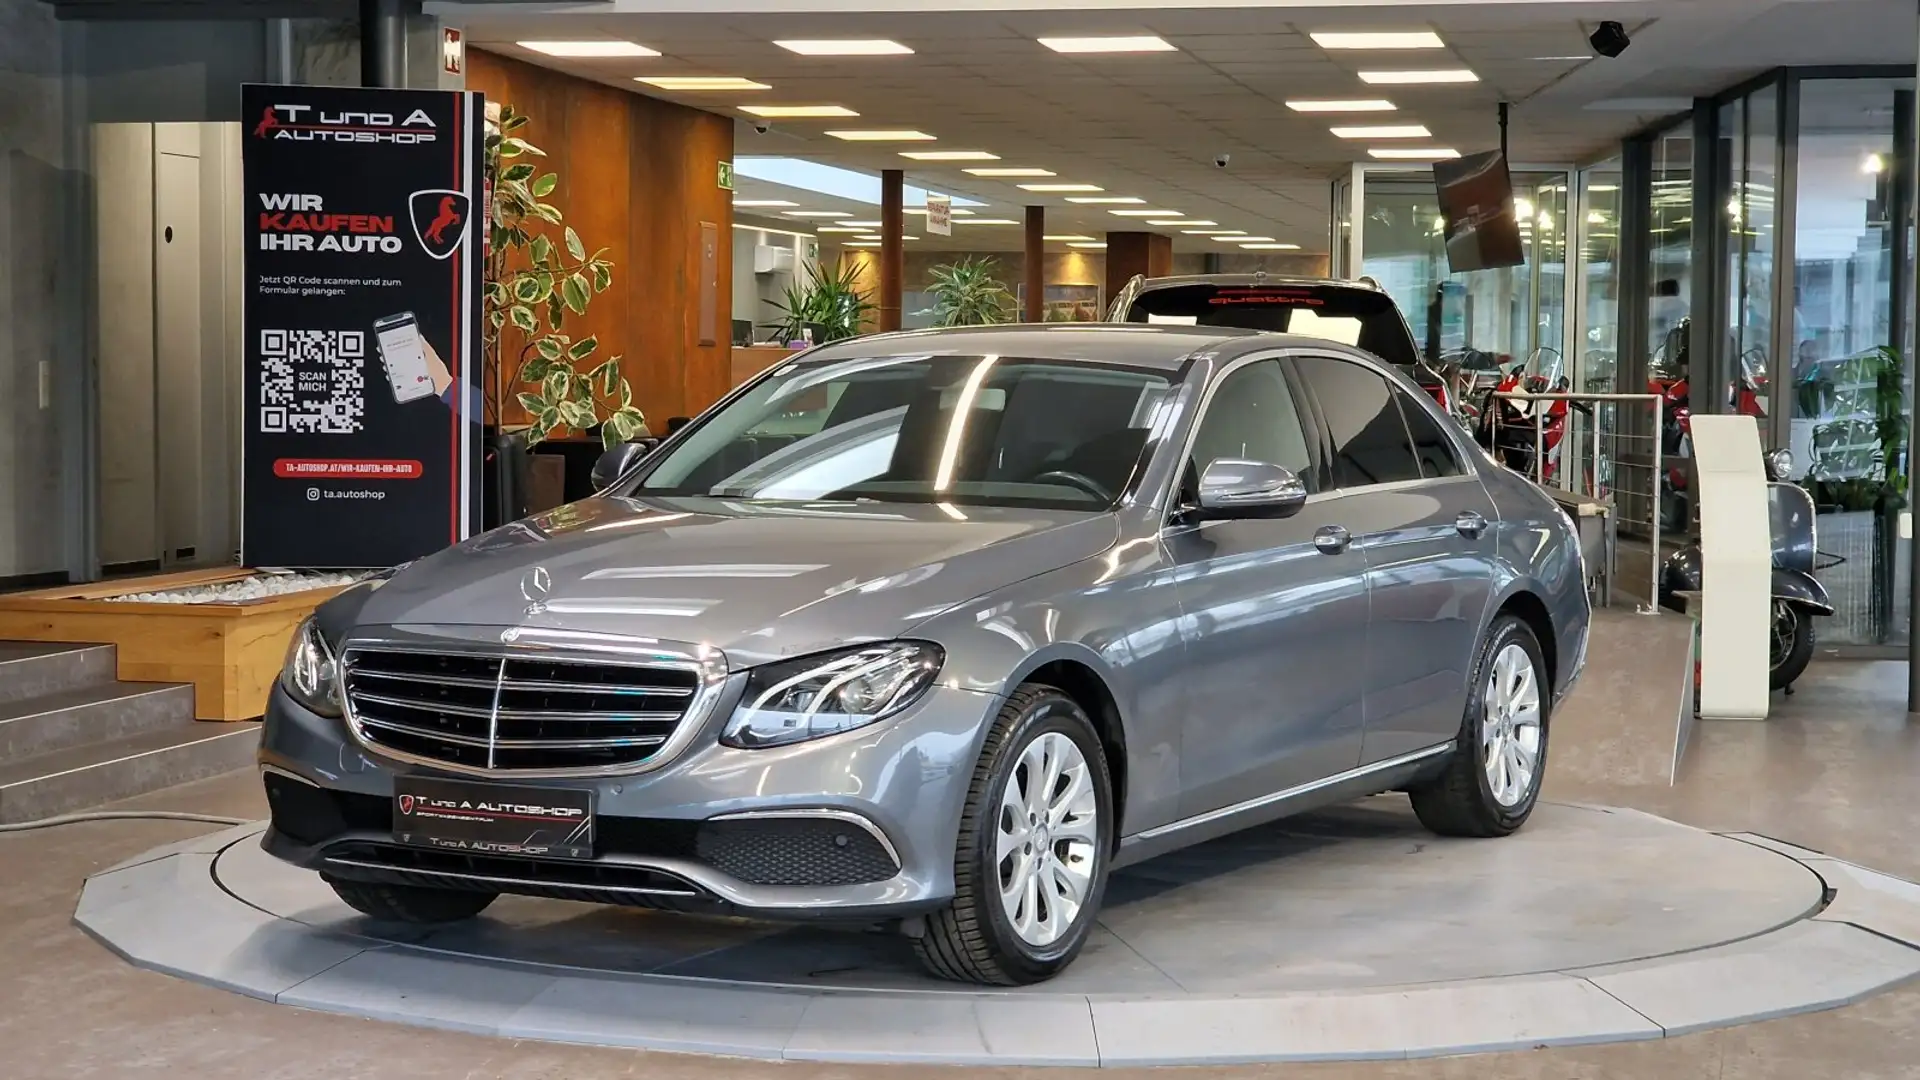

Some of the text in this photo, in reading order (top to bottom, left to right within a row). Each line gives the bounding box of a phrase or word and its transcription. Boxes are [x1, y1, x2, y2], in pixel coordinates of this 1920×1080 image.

[274, 104, 311, 122] T
[401, 109, 437, 127] A
[274, 129, 437, 144] AUTOSHOP
[259, 193, 323, 211] WIR
[259, 213, 393, 233] KAUFEN
[260, 233, 402, 254] IHR AUTO
[260, 275, 402, 287] Jetzt QR Code scannen und zum
[260, 286, 346, 297] Formular gelangen:
[298, 371, 327, 381] SCAN
[298, 382, 327, 392] MICH
[324, 489, 386, 500] ta.autoshop
[416, 796, 427, 805] T
[460, 801, 473, 809] A
[477, 802, 583, 816] AUTOSHOP
[430, 837, 440, 845] T
[457, 840, 468, 849] A
[471, 842, 549, 854] AUTOSHOP
